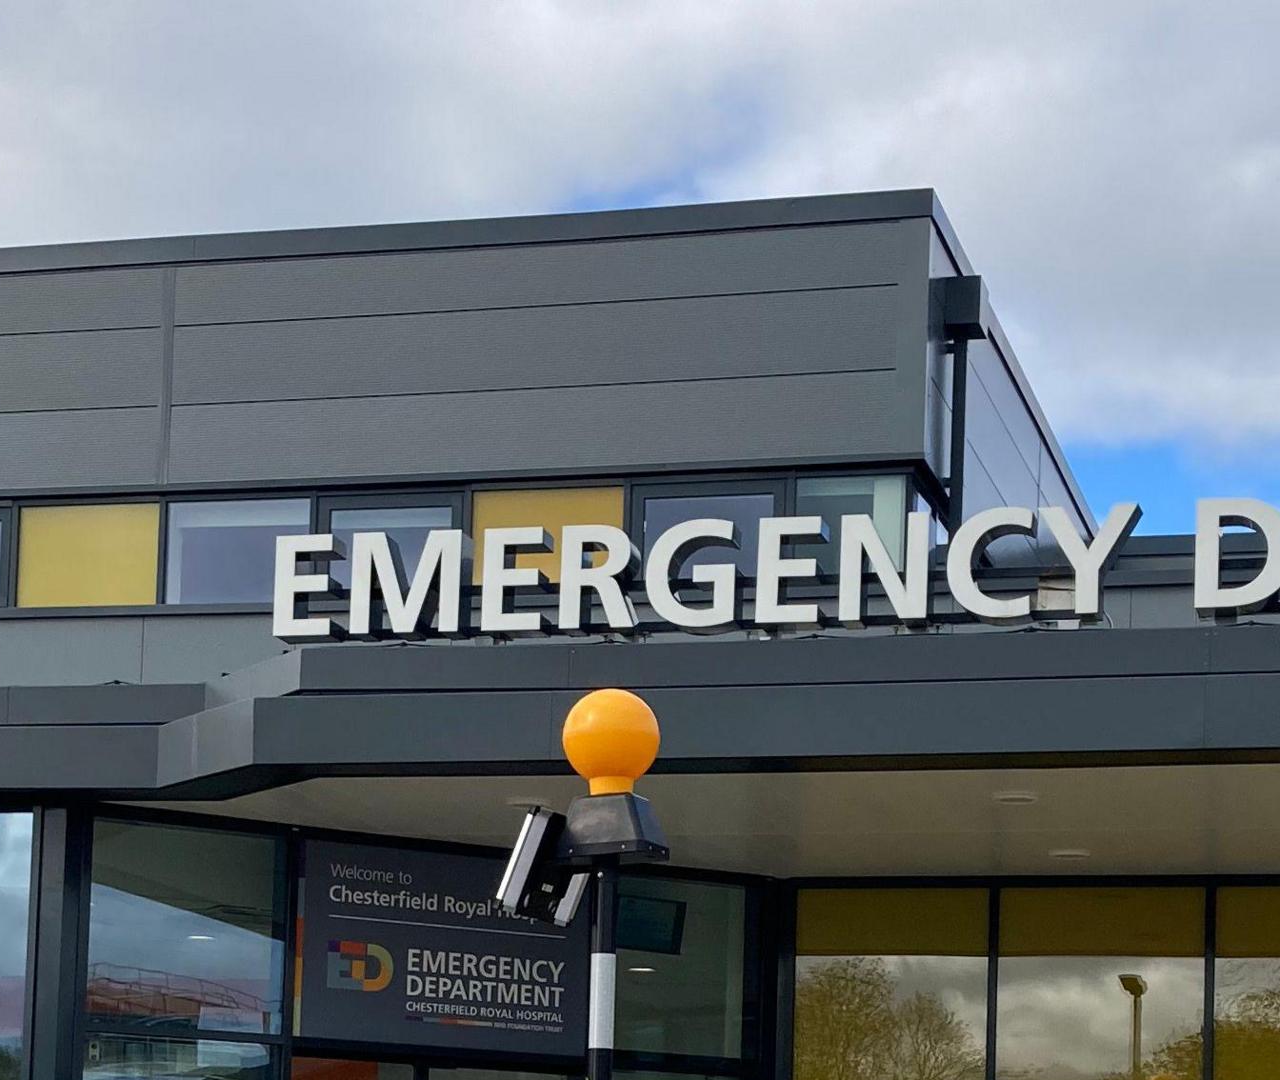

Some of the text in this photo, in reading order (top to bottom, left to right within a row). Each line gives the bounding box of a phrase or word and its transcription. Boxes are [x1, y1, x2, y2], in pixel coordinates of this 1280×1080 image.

[273, 503, 1142, 641] EMERGENCY
[330, 863, 413, 885] Welcome to
[329, 885, 438, 911] Chesterfield
[444, 896, 491, 919] Royal
[407, 949, 565, 984] EMERGENCY
[406, 975, 565, 1008] DEPARTMENT
[405, 1001, 564, 1023] CHESTERFIELD ROYAL HOSPITAL
